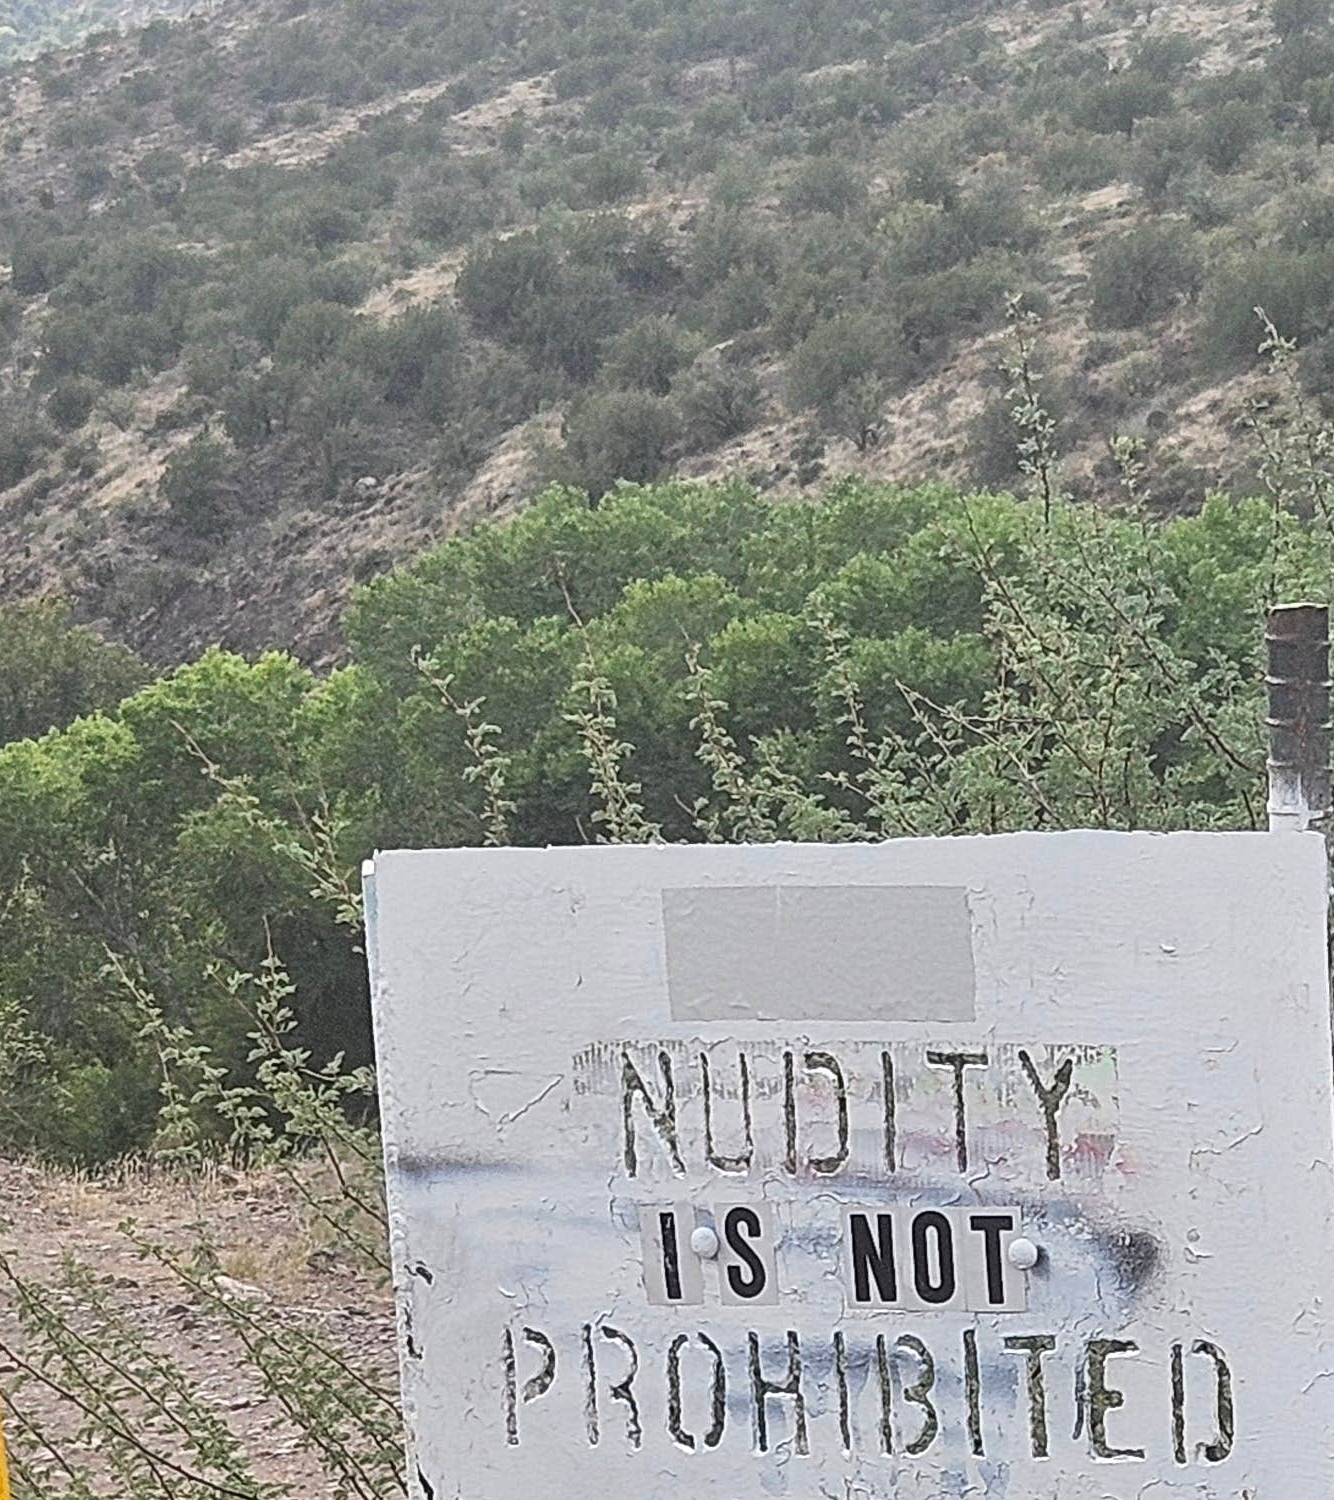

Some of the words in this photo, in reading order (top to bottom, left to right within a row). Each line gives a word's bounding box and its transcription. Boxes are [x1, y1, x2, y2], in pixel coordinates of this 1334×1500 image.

[622, 1050, 1074, 1180] NUDITY
[659, 1206, 768, 1301] IS
[850, 1213, 1015, 1305] NOT
[503, 1326, 1235, 1465] PROHIBITED
